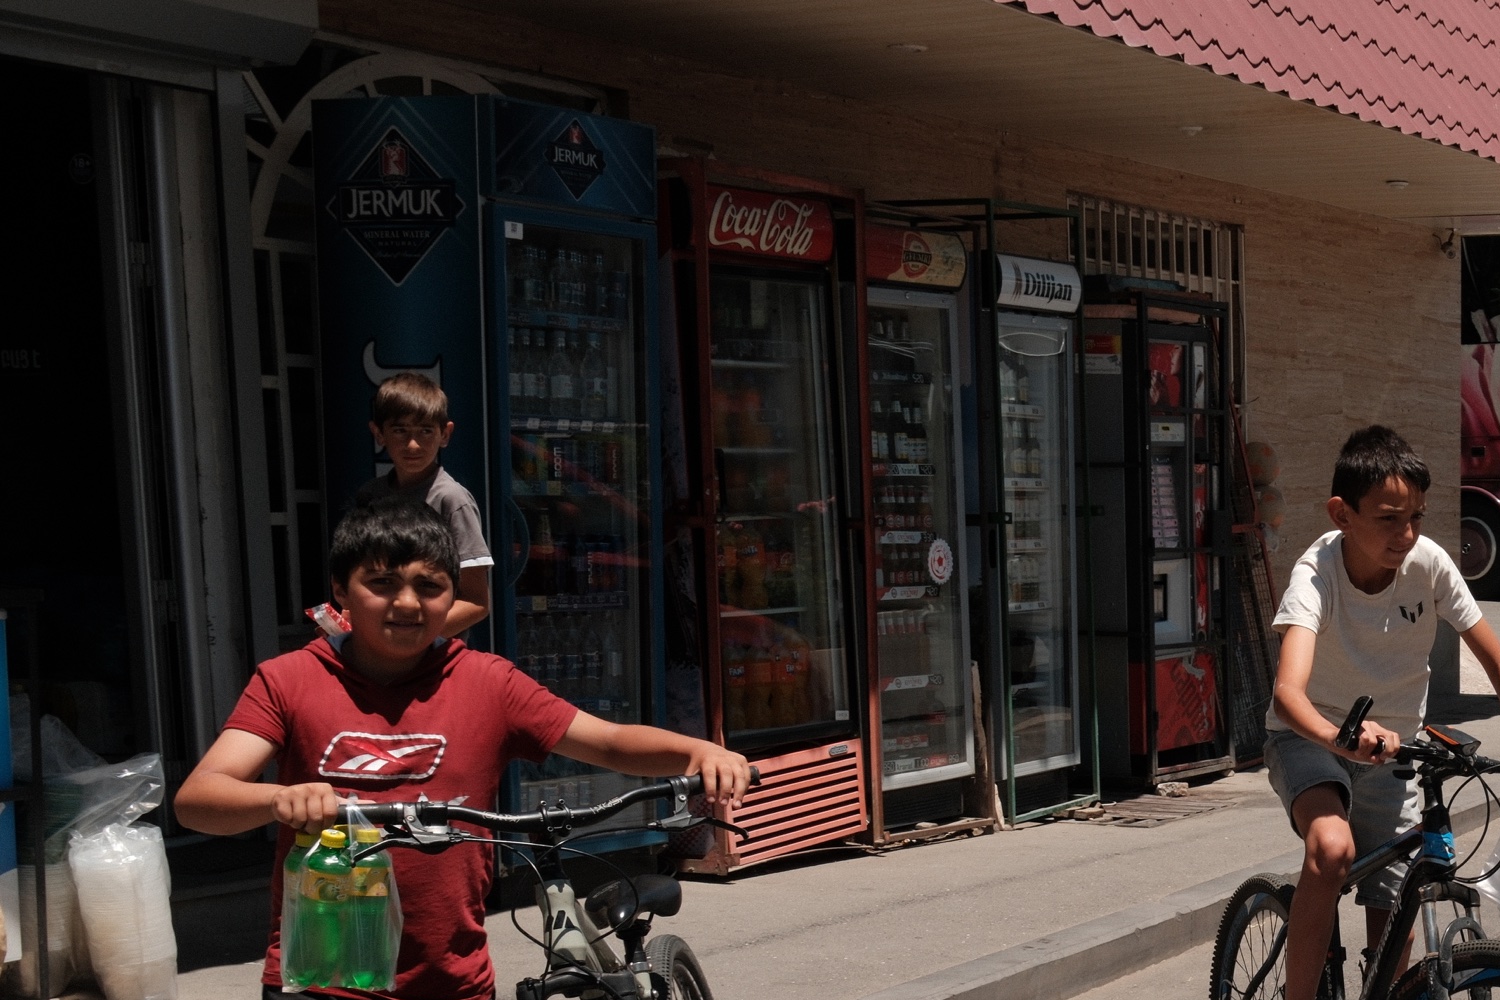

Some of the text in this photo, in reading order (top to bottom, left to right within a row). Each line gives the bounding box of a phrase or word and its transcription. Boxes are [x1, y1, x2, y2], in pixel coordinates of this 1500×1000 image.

[553, 146, 598, 169] JERMUK
[347, 188, 444, 219] JERMUK
[402, 230, 431, 239] WATER
[1024, 272, 1072, 303] Dilijan
